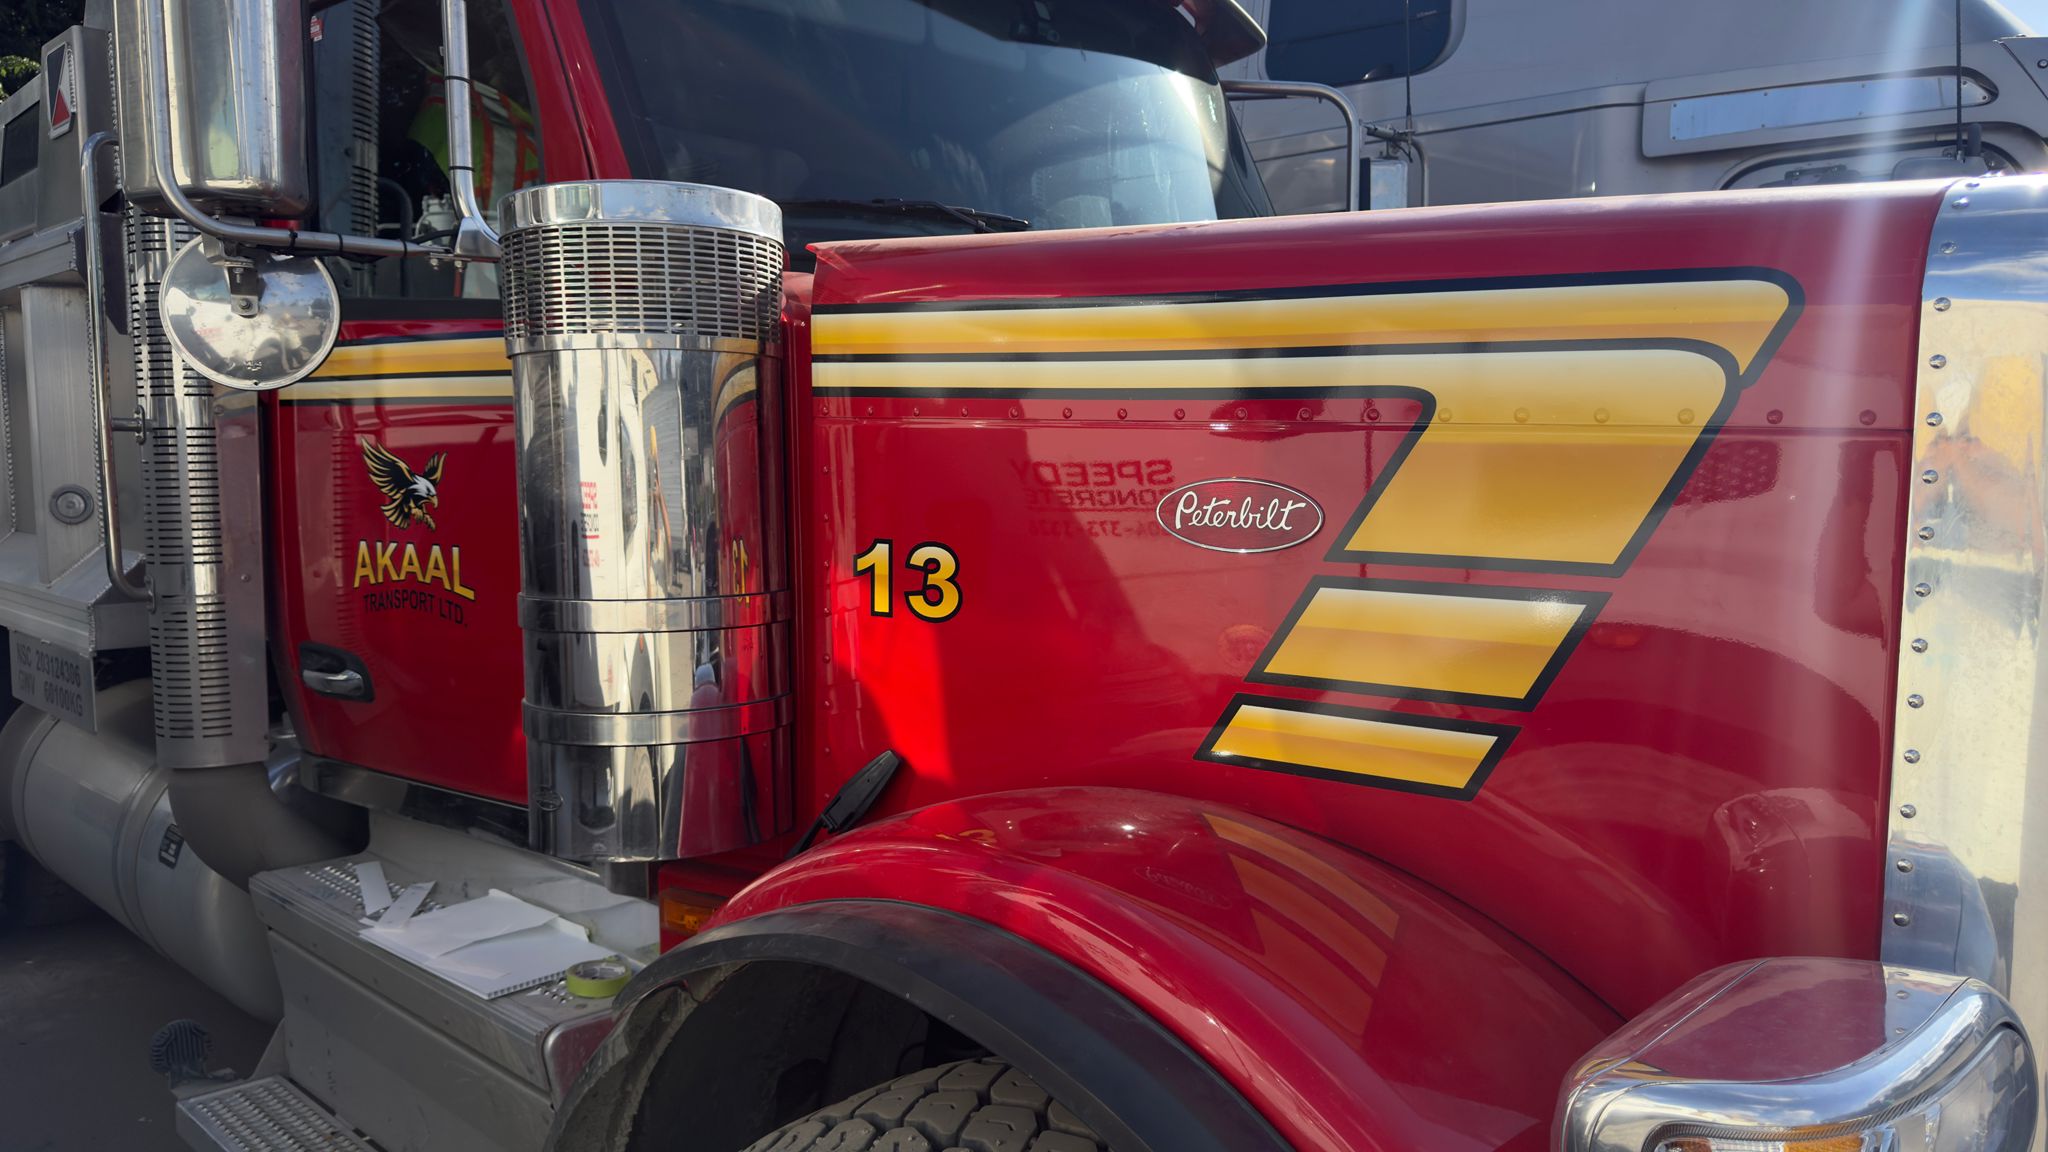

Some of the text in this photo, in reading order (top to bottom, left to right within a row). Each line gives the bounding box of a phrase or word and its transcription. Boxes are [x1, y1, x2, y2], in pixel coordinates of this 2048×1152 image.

[1175, 490, 1307, 531] Peterbilt
[352, 539, 477, 602] AKAAL
[852, 538, 963, 624] 13
[363, 589, 434, 613] TRANSPORT
